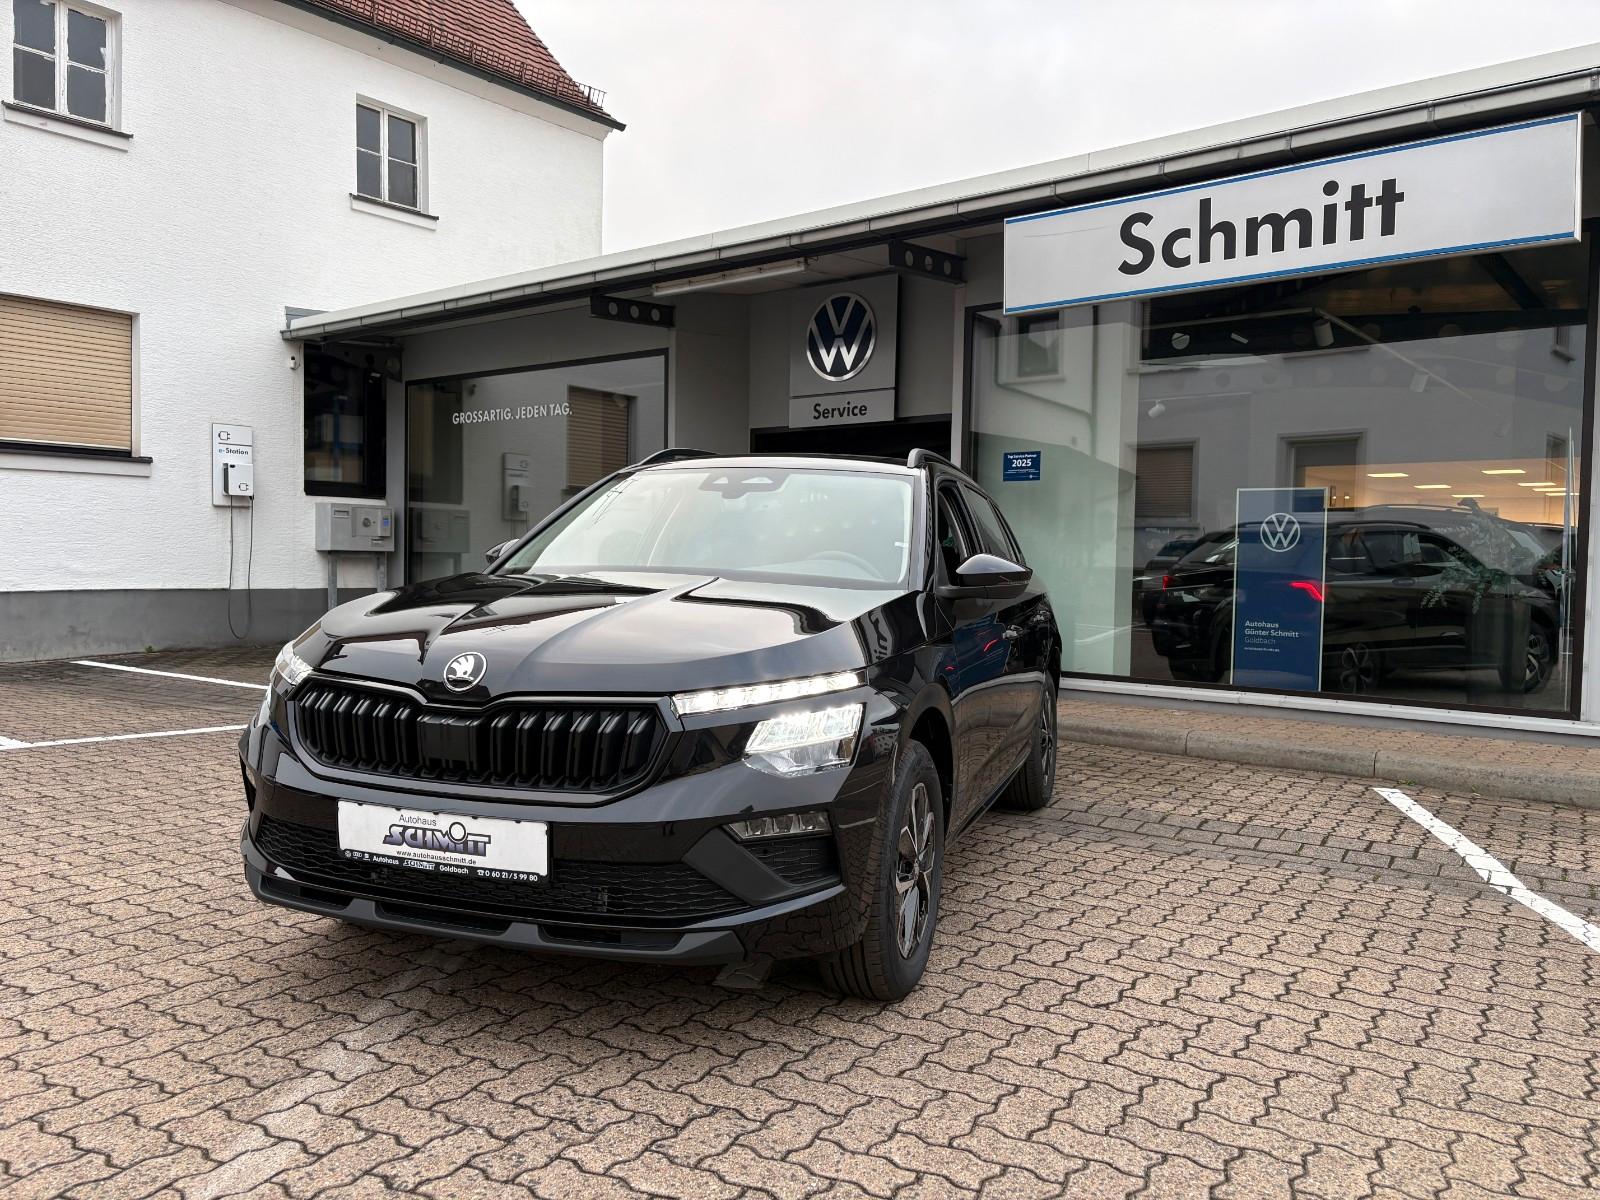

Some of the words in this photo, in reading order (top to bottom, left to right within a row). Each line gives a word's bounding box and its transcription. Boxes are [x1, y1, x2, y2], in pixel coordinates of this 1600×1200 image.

[1117, 178, 1405, 276] Schmitt
[452, 408, 514, 424] GROSSARTIG.
[515, 404, 547, 419] JEDEN
[549, 402, 573, 416] TAG.
[813, 401, 867, 420] Service
[1011, 459, 1032, 467] 2025
[1244, 620, 1279, 628] Autohaus
[1244, 628, 1269, 636] Günter
[1270, 630, 1299, 638] Schmitt
[1244, 636, 1276, 645] Goldbach
[398, 813, 437, 827] Autohaus
[396, 850, 477, 865] www.autohausschmitt.de
[372, 855, 400, 865] Autohaus
[439, 864, 469, 875] Goldbach
